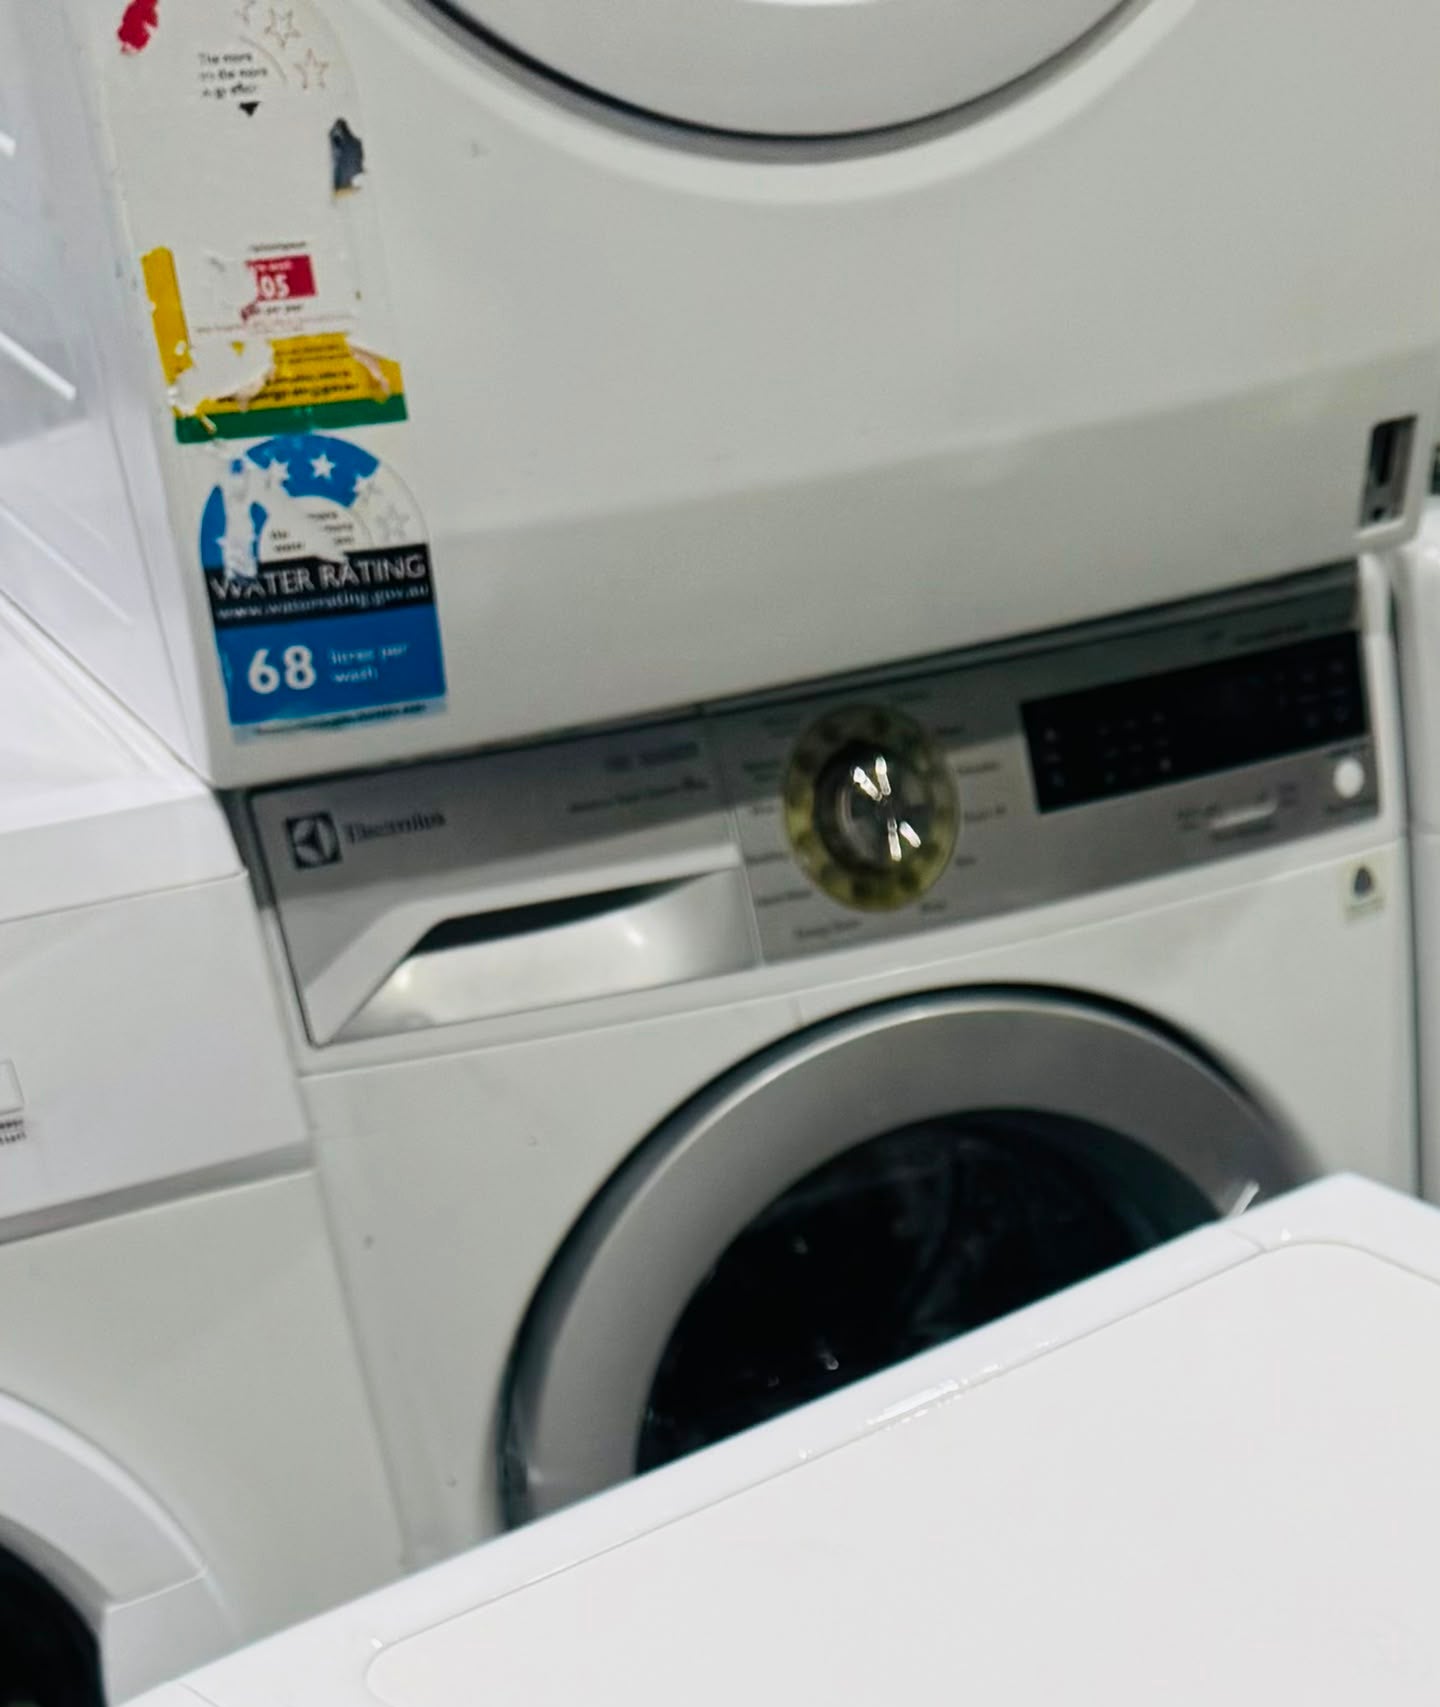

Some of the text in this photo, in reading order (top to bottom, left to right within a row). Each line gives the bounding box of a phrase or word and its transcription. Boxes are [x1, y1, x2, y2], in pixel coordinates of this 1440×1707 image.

[211, 553, 427, 600] WATER RATING
[248, 645, 317, 694] 68
